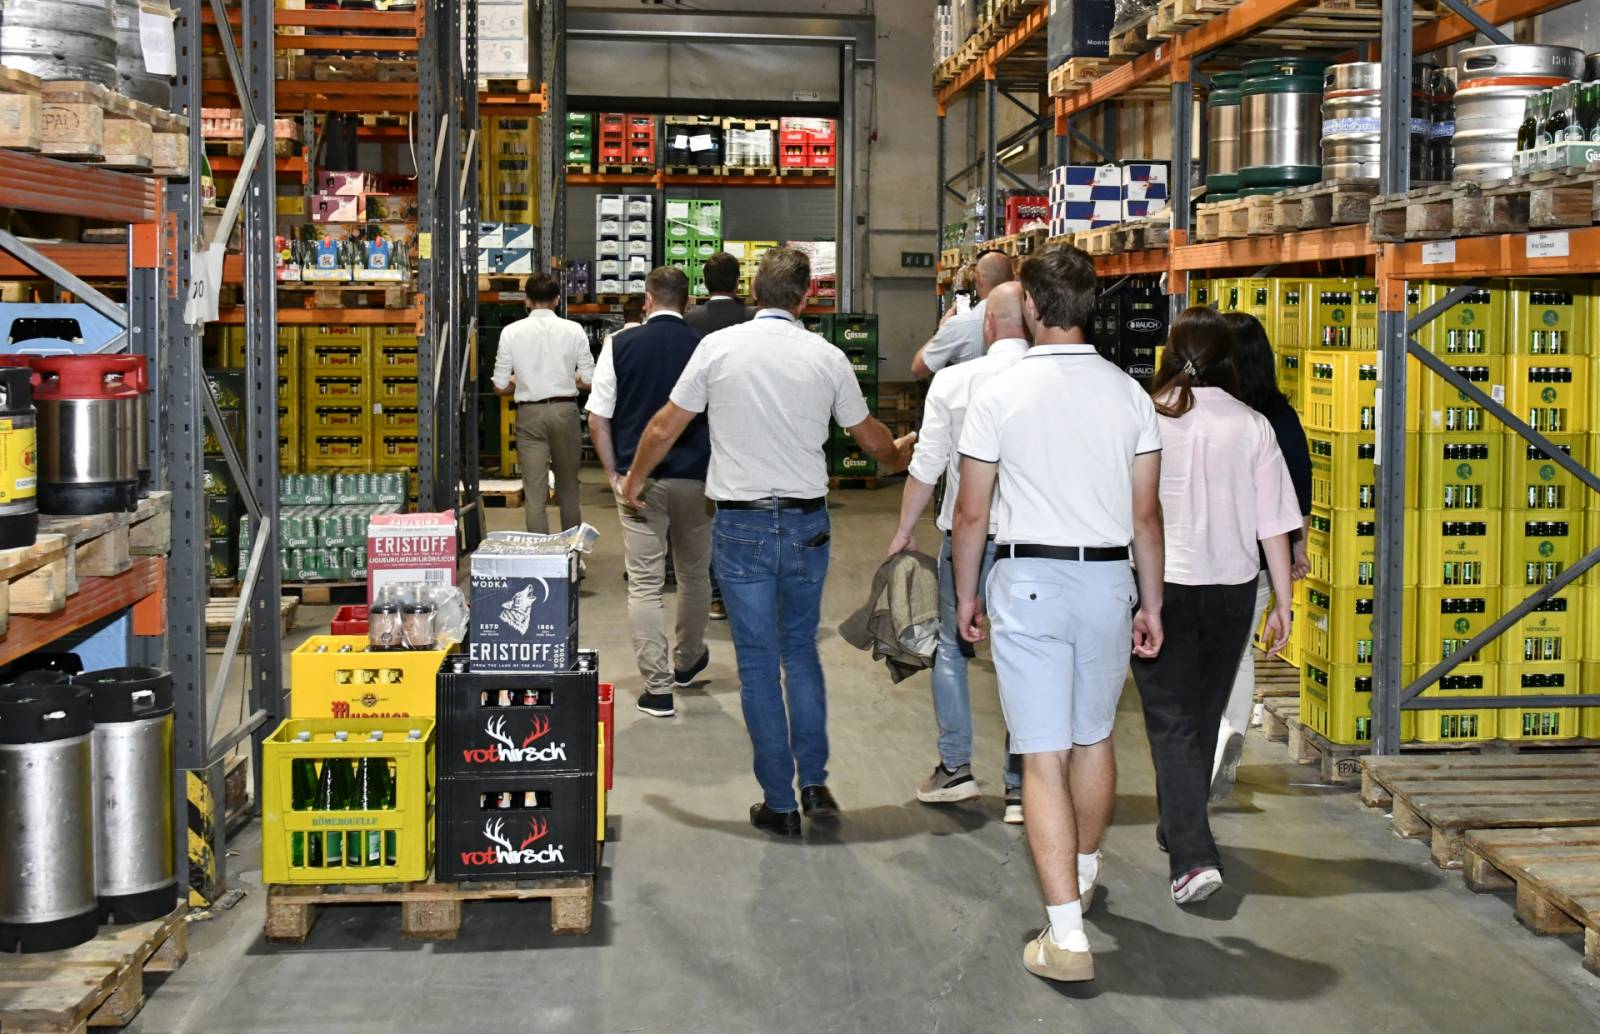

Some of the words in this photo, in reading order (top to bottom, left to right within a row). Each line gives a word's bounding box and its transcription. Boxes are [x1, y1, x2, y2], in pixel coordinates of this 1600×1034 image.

[1135, 321, 1159, 329] RAUCH
[844, 328, 868, 340] Gösser
[843, 456, 867, 468] Gösser
[375, 537, 449, 553] ERISTOFF
[472, 581, 509, 589] WODKA
[470, 643, 552, 661] ERISTOFF
